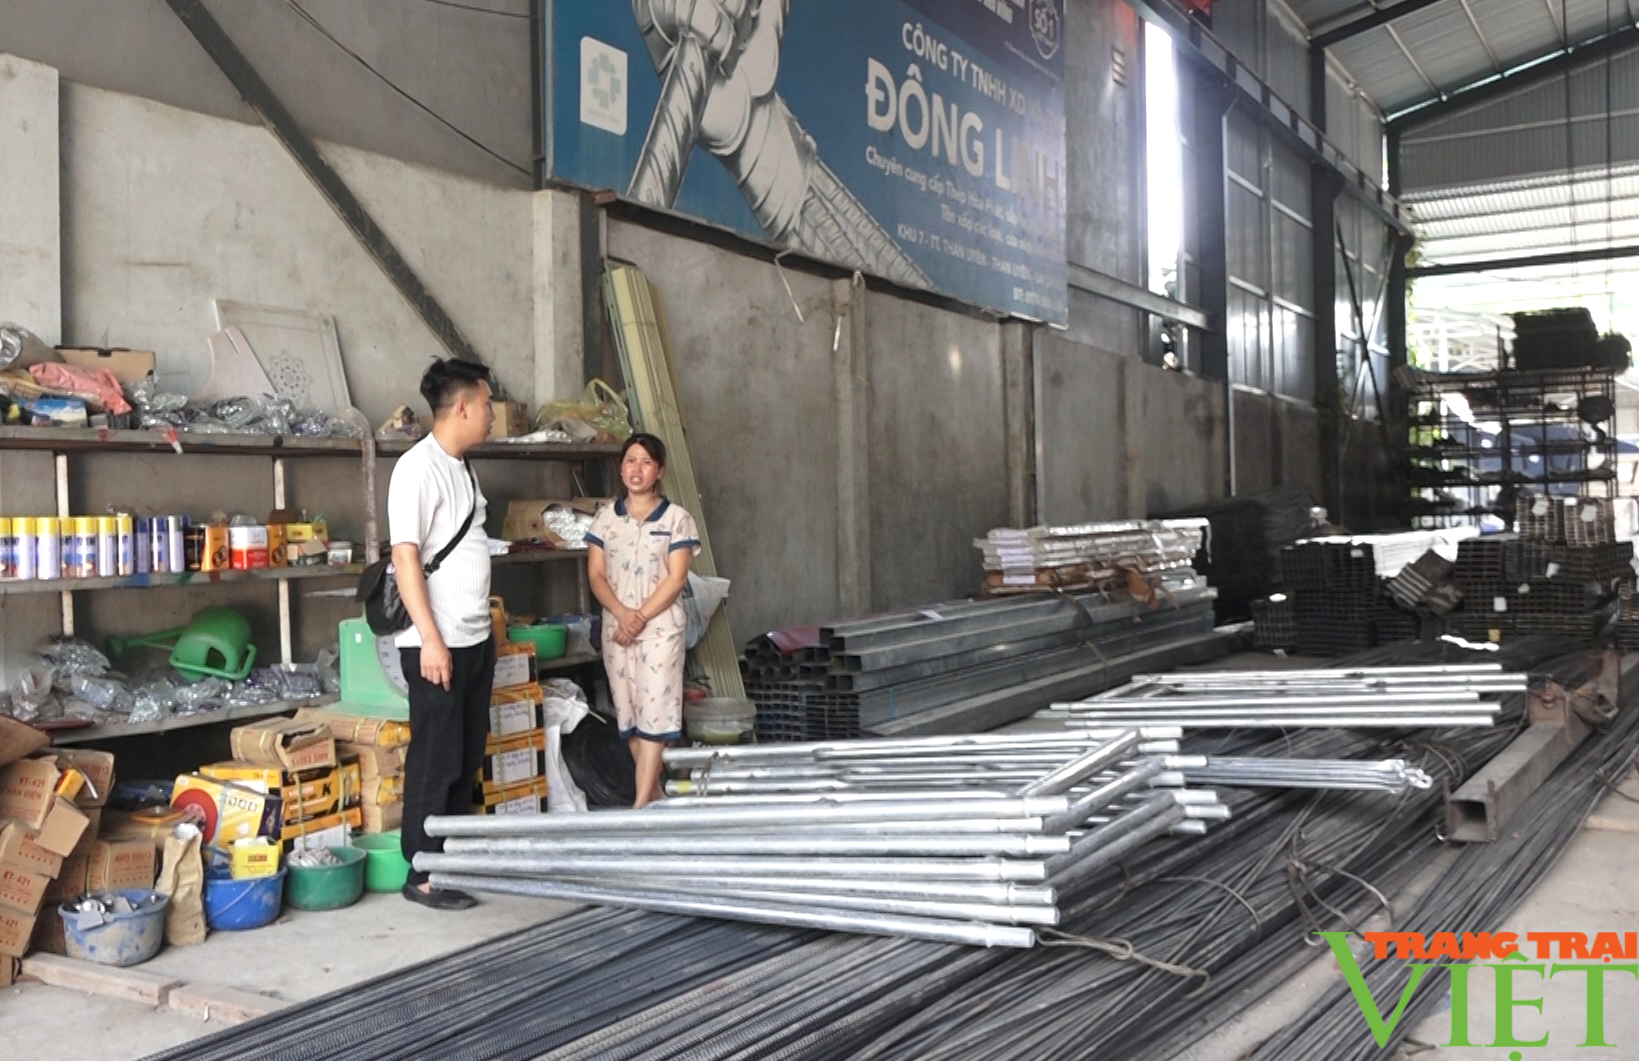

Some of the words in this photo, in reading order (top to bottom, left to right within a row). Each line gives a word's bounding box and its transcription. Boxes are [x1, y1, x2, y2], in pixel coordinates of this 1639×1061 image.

[902, 22, 948, 70] CÔNG
[951, 50, 968, 82] TY
[970, 63, 1007, 104] TNHH
[865, 57, 984, 177] ĐÔNG
[865, 145, 902, 176] Chuyên
[905, 165, 927, 192] cung
[929, 173, 945, 197] cấp
[897, 222, 918, 244] KHU
[918, 231, 925, 244] 7
[943, 239, 965, 262] THAN
[966, 247, 987, 267] UYÊN
[19, 776, 46, 788] KT-421
[2, 870, 31, 887] KT-421
